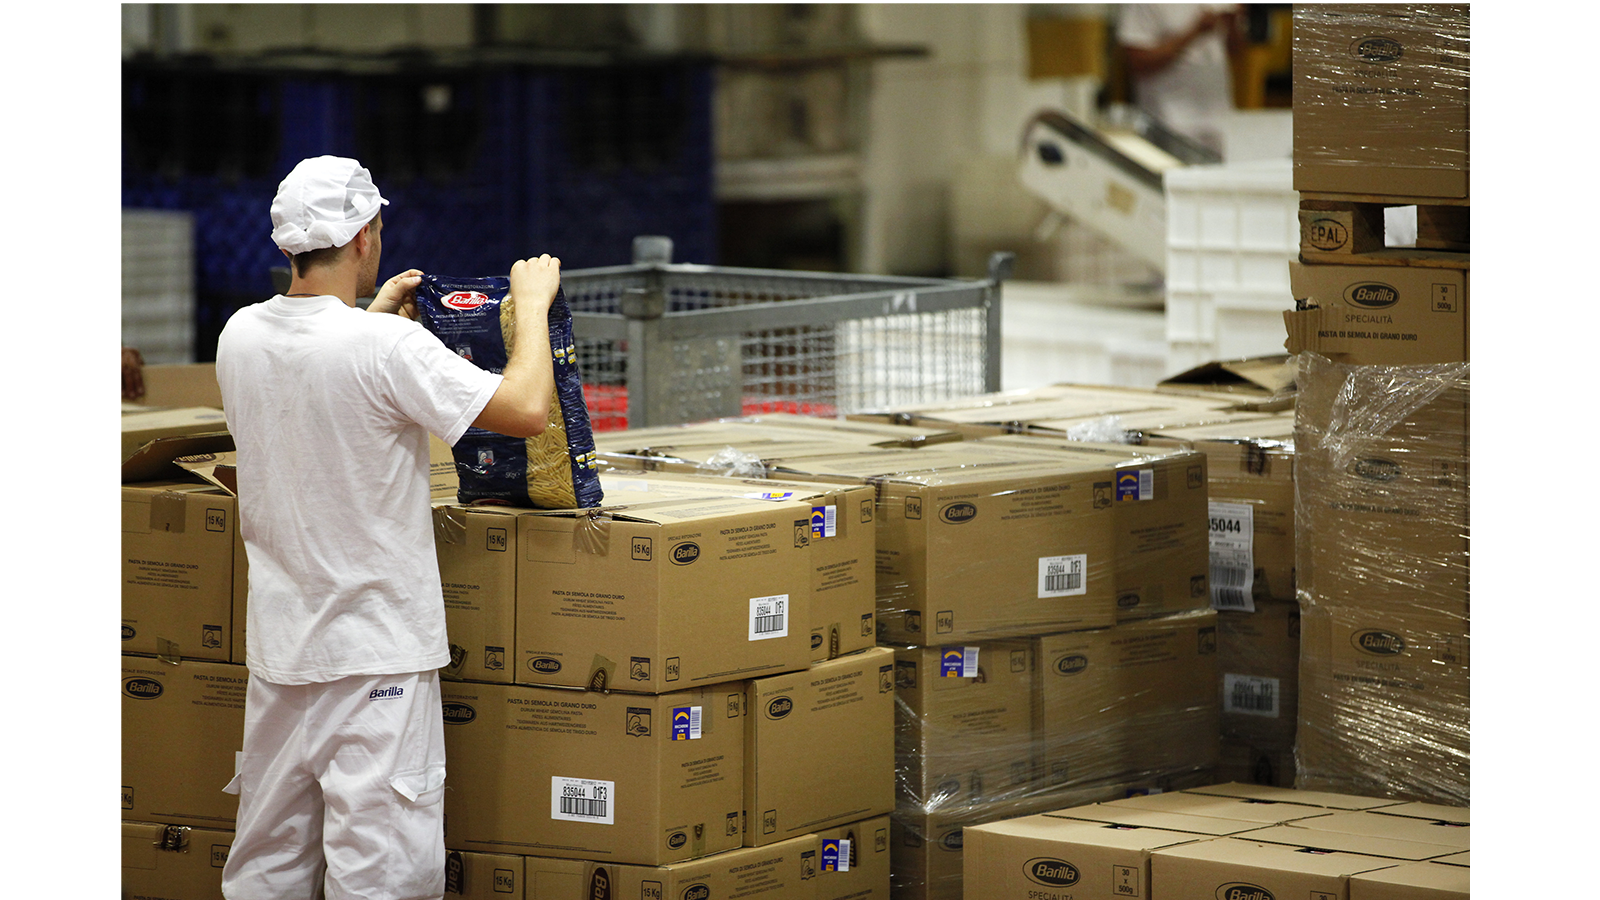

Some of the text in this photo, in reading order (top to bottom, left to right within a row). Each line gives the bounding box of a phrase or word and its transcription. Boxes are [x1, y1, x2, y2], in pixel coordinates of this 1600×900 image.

[1311, 226, 1341, 243] EPAL
[452, 294, 486, 305] Barilla
[1356, 287, 1395, 302] Barilla
[1437, 302, 1452, 310] 500g
[1345, 314, 1393, 324] SPECIALITÀ
[1318, 330, 1418, 341] PASTA DI SEMOLA DI GRANO DURO
[906, 503, 920, 515] 15 Kg
[948, 506, 974, 518] Barilla
[208, 516, 223, 528] 15 Kg
[489, 535, 504, 547] 15 Kg
[634, 544, 650, 556] 15 Kg
[676, 546, 698, 559] Barilla
[534, 659, 559, 671] Barilla
[193, 674, 209, 682] PASTA
[216, 676, 237, 684] SEMOLA
[129, 682, 161, 694] Barilla
[369, 686, 404, 699] Barilla
[531, 699, 553, 707] SEMOLA
[560, 701, 580, 709] GRANO
[581, 702, 597, 710] DURO
[771, 700, 791, 714] Barilla
[563, 785, 608, 800] 835044 01F3
[124, 794, 132, 805] Kg
[213, 851, 219, 860] 15
[1036, 864, 1075, 880] Barilla
[495, 876, 512, 887] 15 Kg
[643, 888, 660, 899] 15 Kg
[1118, 885, 1134, 895] 500g
